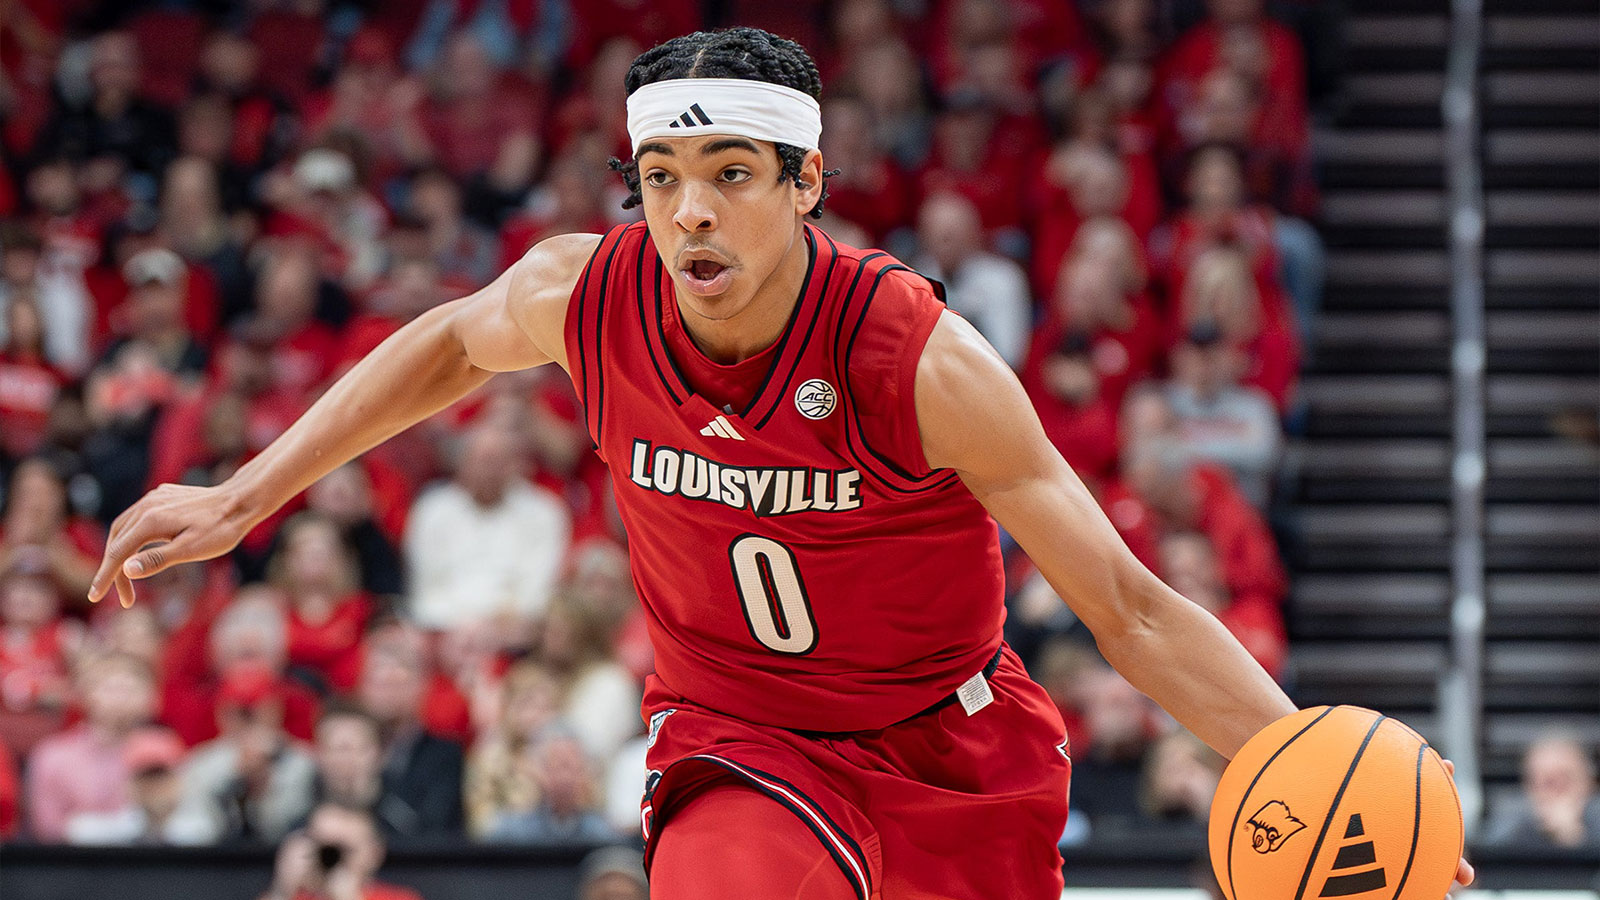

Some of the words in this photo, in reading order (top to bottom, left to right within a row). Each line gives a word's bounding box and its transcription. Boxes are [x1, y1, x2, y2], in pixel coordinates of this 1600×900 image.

[801, 392, 833, 402] ACC
[631, 439, 863, 517] LOUISVILLE
[729, 533, 819, 655] 0
